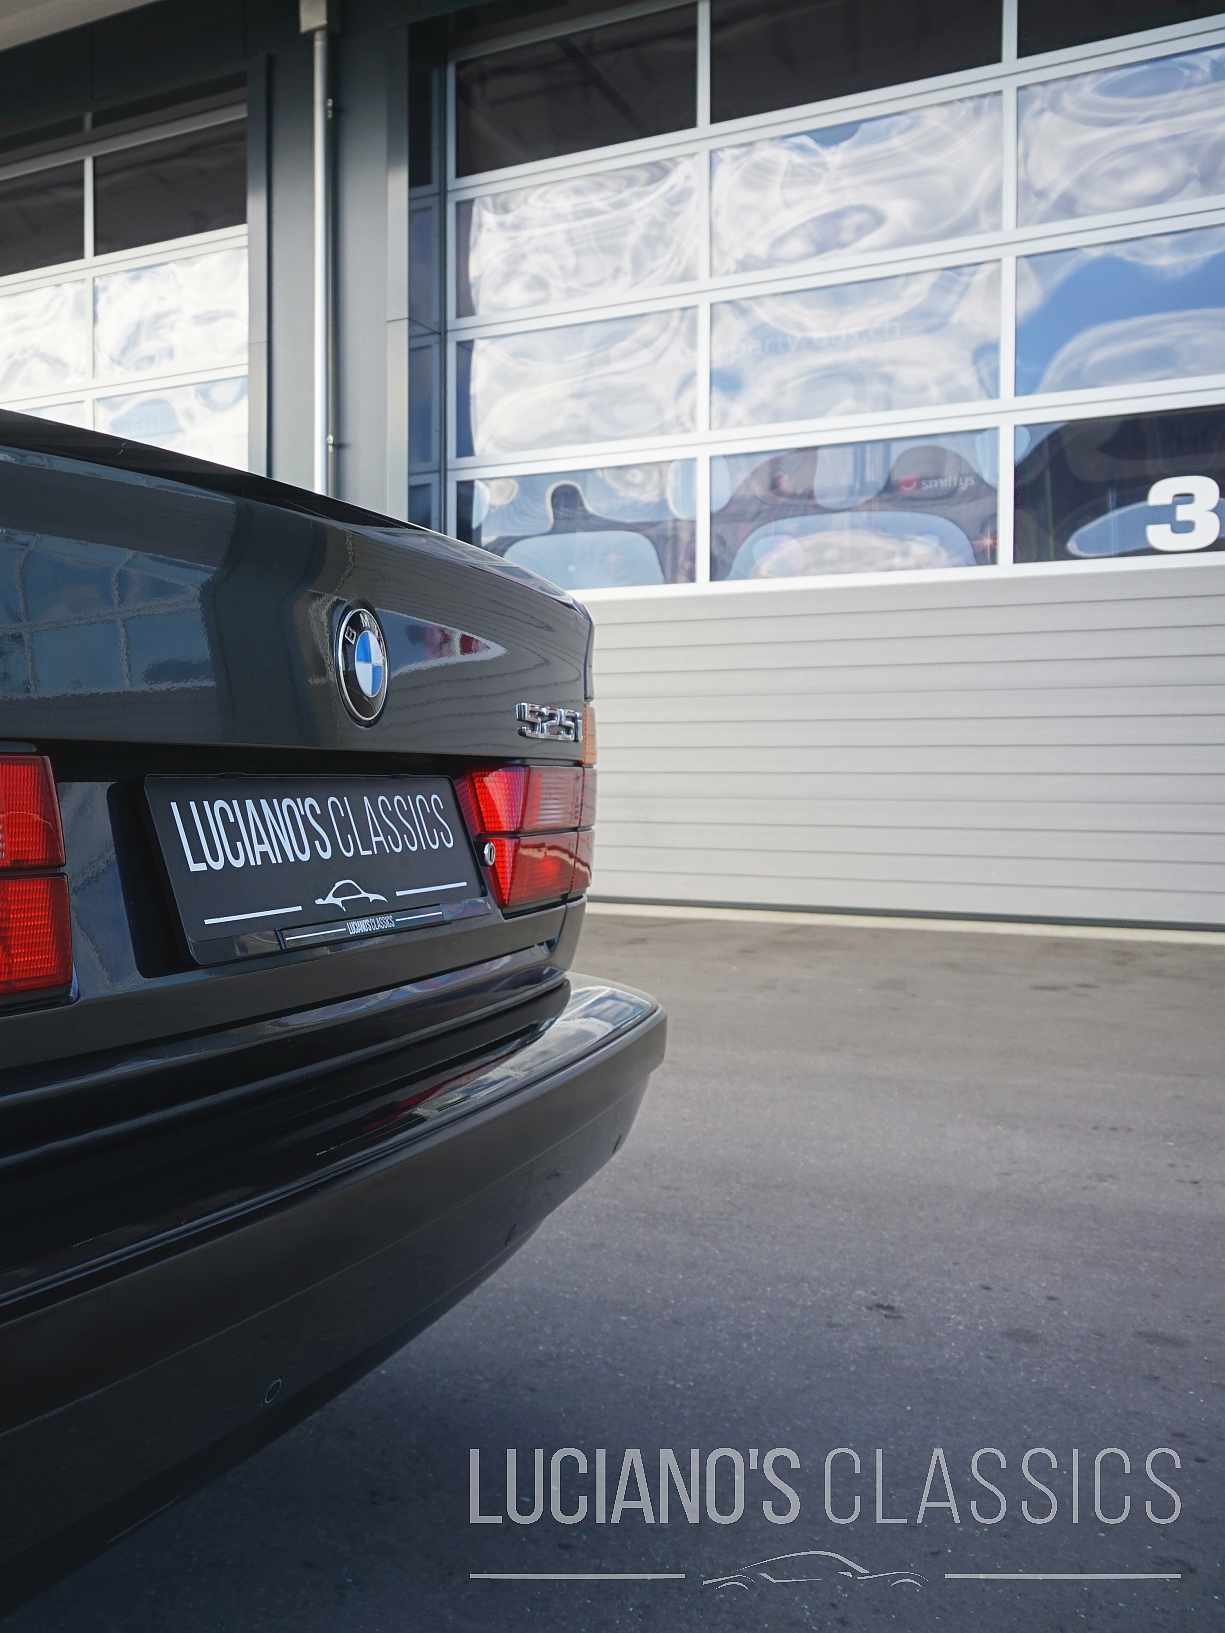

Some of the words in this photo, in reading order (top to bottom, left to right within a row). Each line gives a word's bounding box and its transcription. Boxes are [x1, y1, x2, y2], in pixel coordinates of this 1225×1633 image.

[1146, 475, 1220, 551] 3
[344, 613, 386, 661] BMW
[170, 797, 332, 872] LUCIANO'S
[327, 794, 454, 858] CLASSICS
